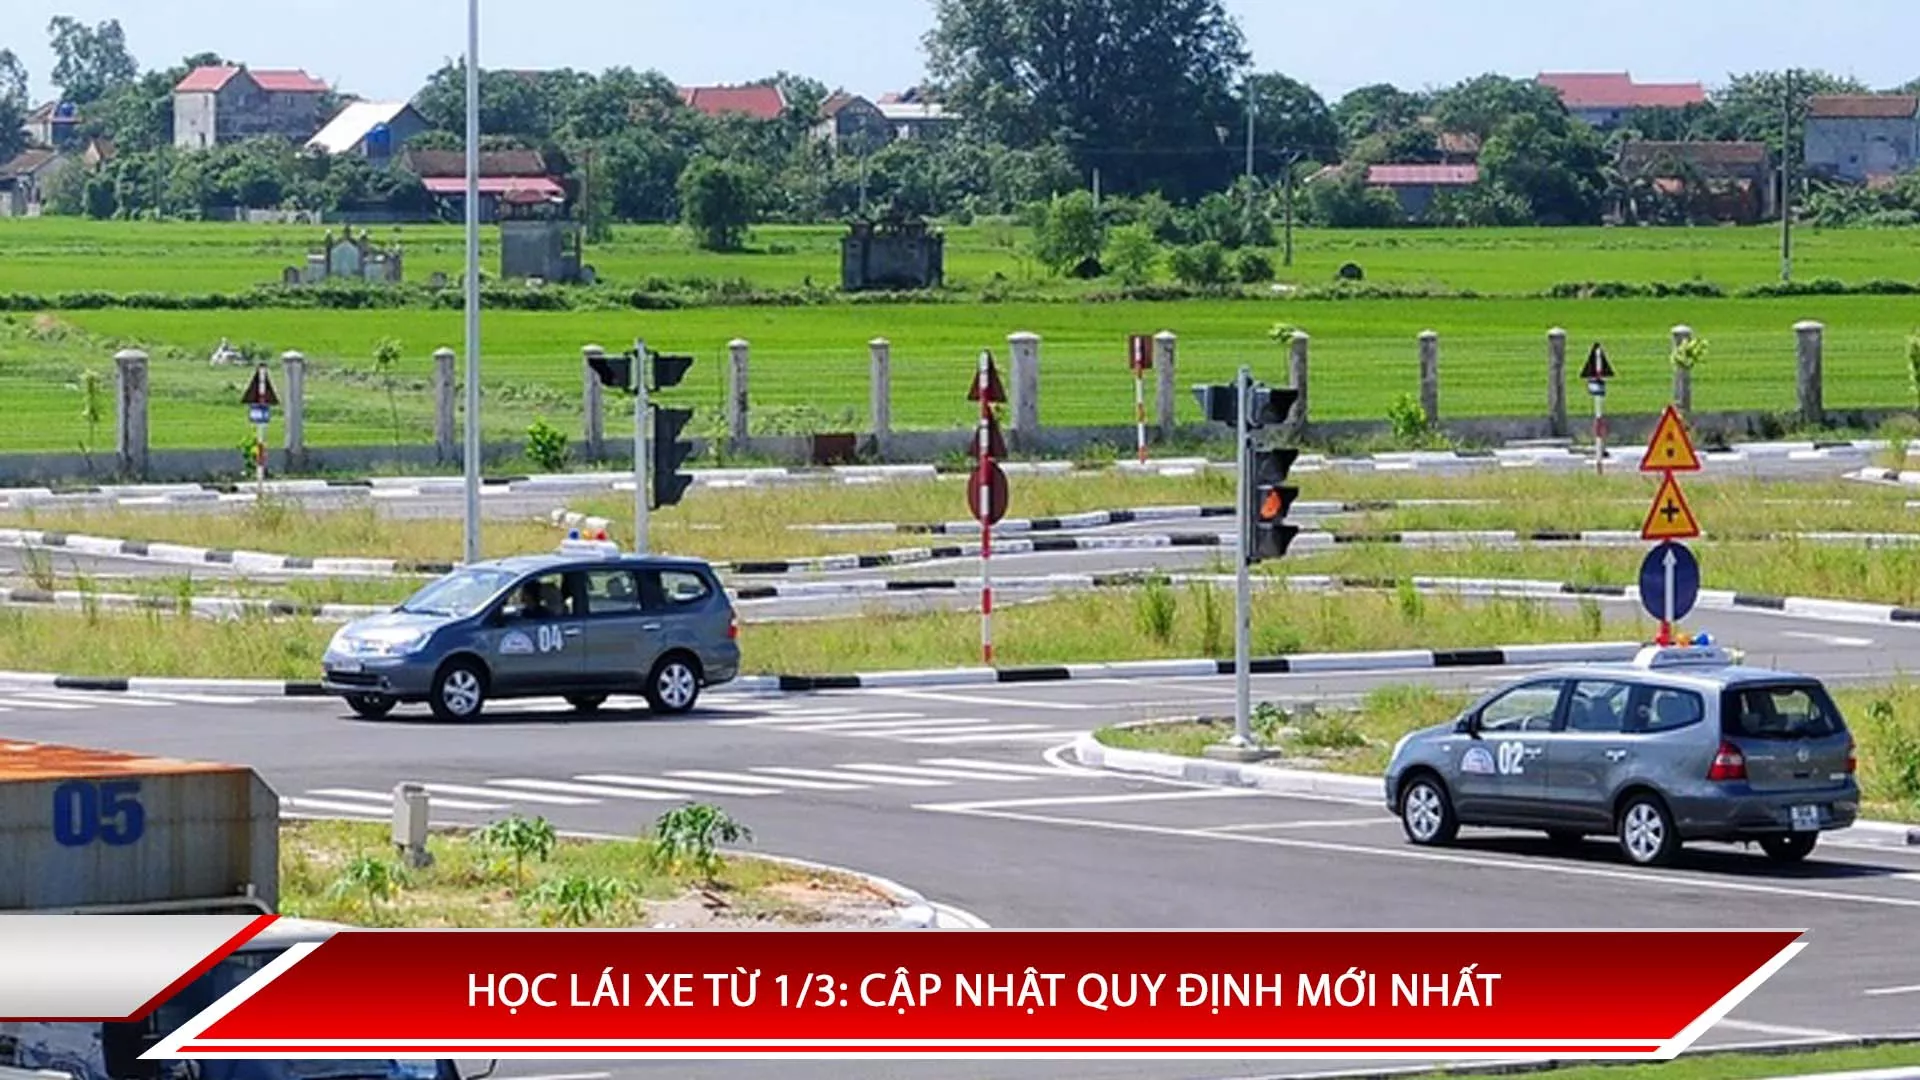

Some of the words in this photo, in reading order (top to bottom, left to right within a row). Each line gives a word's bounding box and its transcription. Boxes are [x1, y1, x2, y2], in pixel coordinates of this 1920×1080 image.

[538, 624, 564, 653] 04
[1498, 741, 1524, 775] 02
[53, 780, 145, 847] 05
